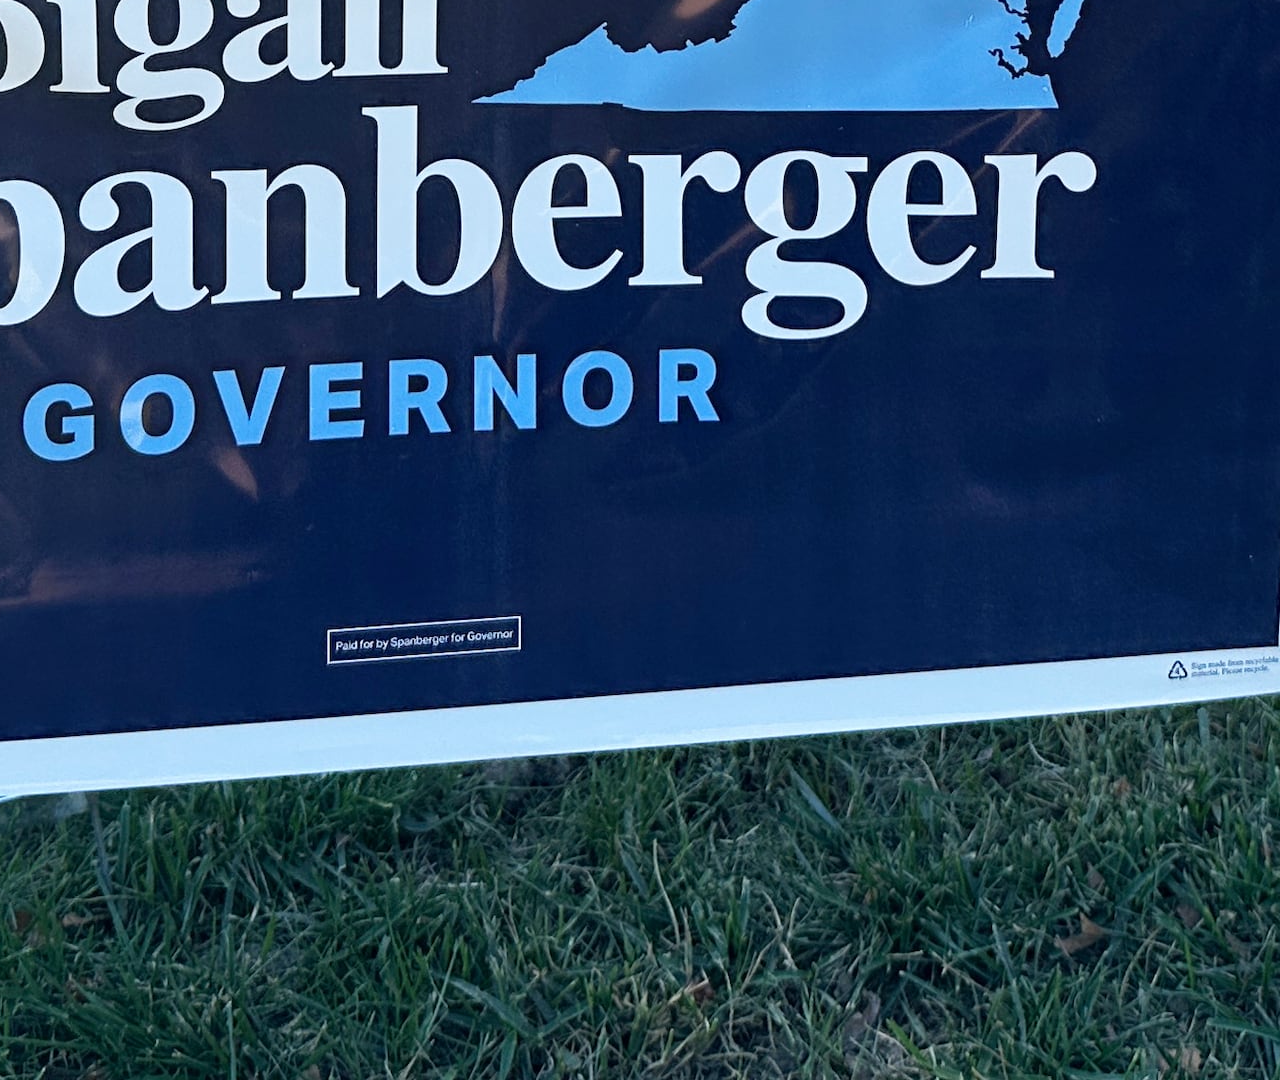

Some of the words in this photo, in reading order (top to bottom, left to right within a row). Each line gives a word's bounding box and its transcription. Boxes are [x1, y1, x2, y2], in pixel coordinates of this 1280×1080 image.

[23, 348, 720, 461] GOVERNOR
[336, 639, 359, 651] Paid
[359, 639, 374, 650] for
[375, 639, 388, 650] by
[390, 634, 449, 649] Spanberger
[451, 632, 465, 642] for
[467, 630, 514, 642] Governor
